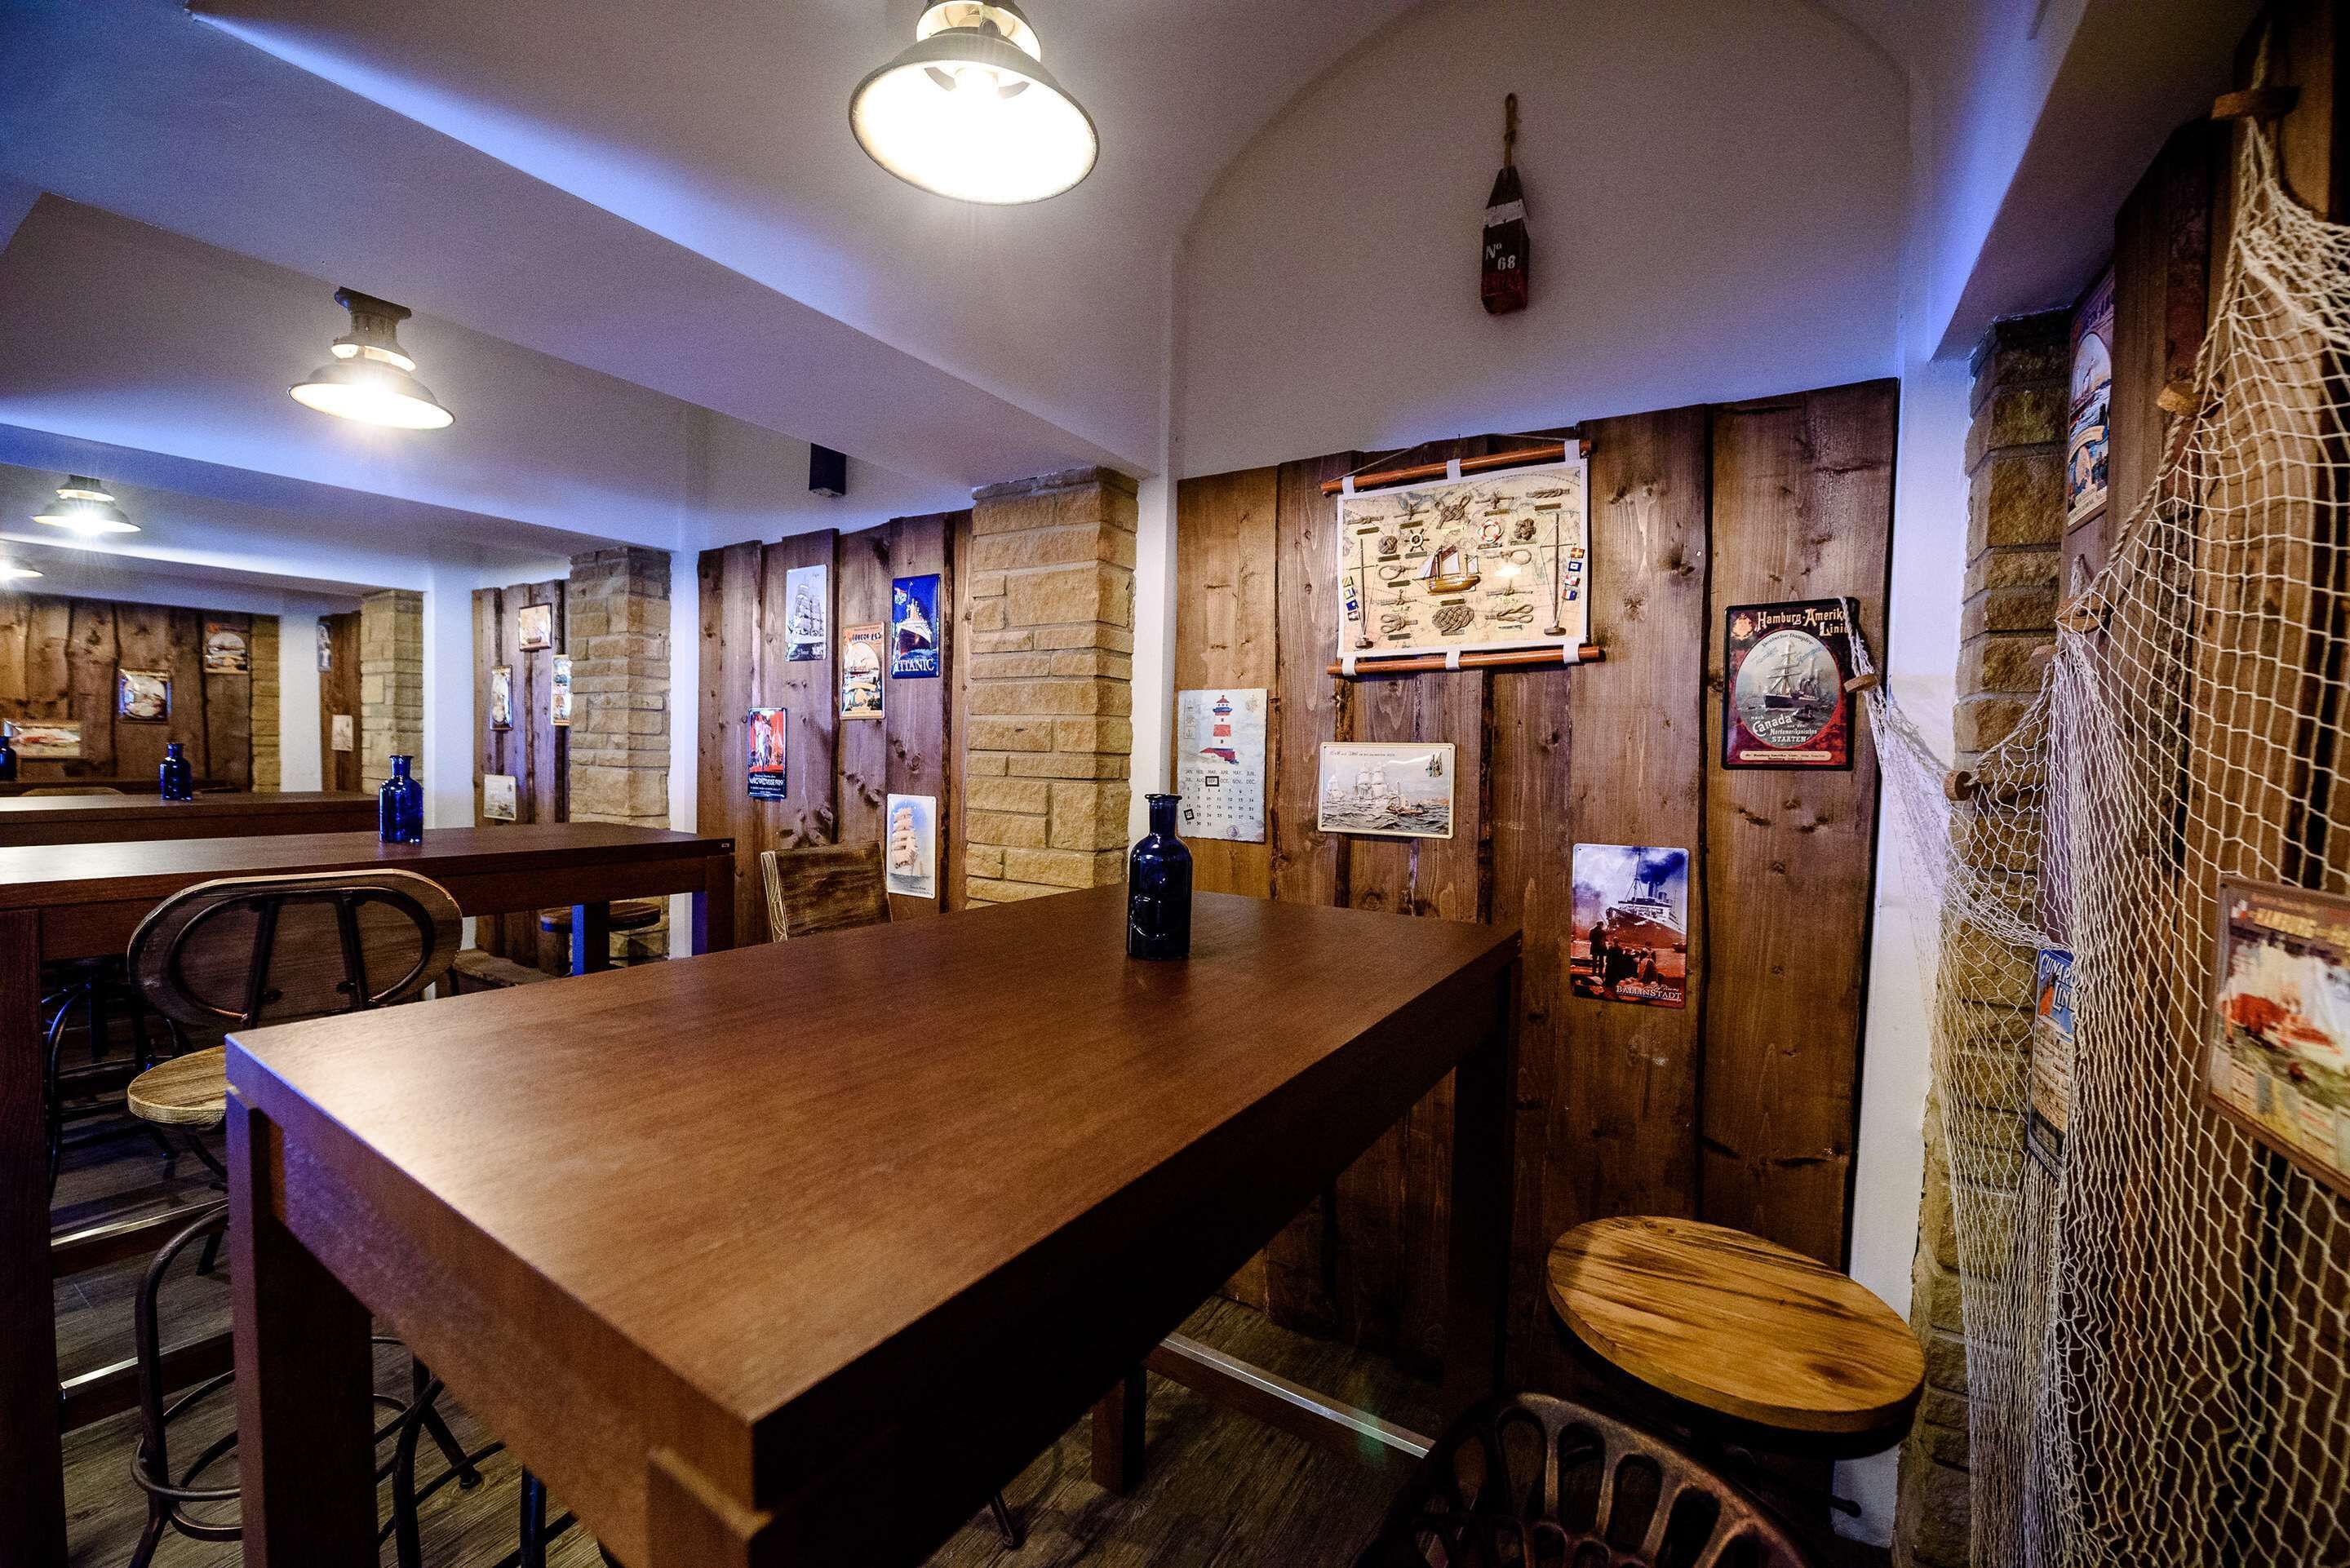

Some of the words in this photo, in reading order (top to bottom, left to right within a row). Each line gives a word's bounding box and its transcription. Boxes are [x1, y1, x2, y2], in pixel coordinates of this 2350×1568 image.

[1497, 255, 1516, 270] 68
[893, 658, 934, 671] TITANIC
[1753, 713, 1793, 737] Canada
[1616, 985, 1682, 999] BALLINSTADT
